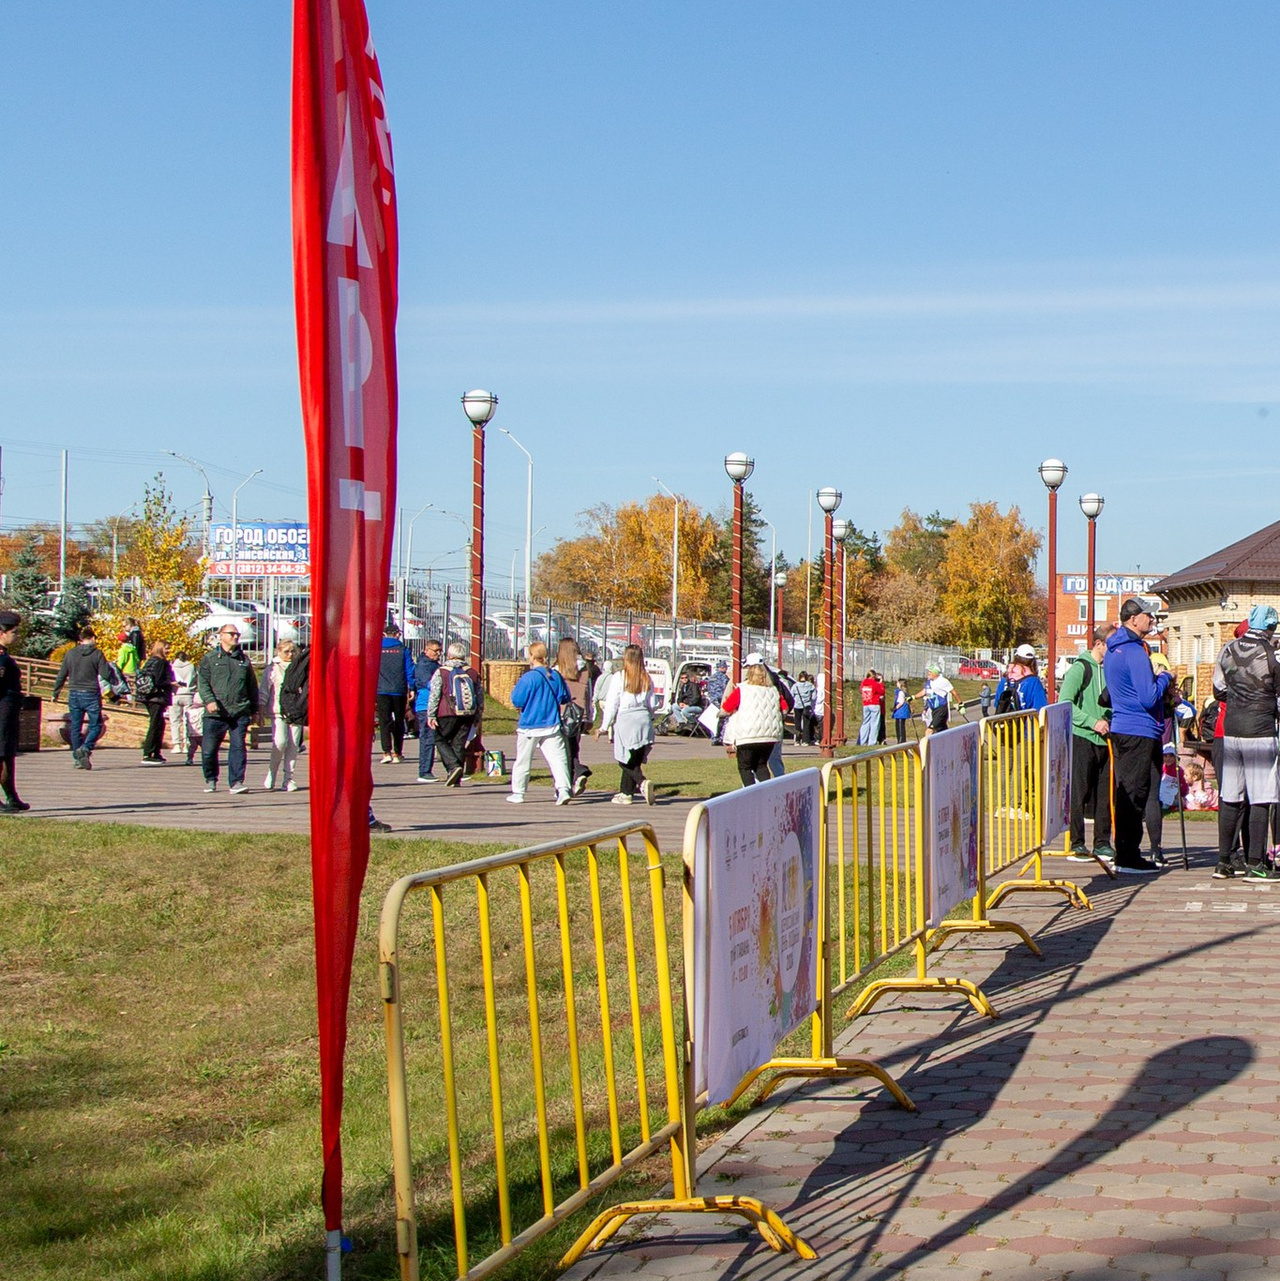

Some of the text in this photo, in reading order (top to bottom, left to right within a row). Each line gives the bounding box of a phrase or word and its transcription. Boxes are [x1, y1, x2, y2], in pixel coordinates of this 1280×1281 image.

[215, 528, 264, 546] ГОРОД
[266, 564, 306, 574] 34-04-25
[1066, 577, 1154, 593] ГООД ОБО
